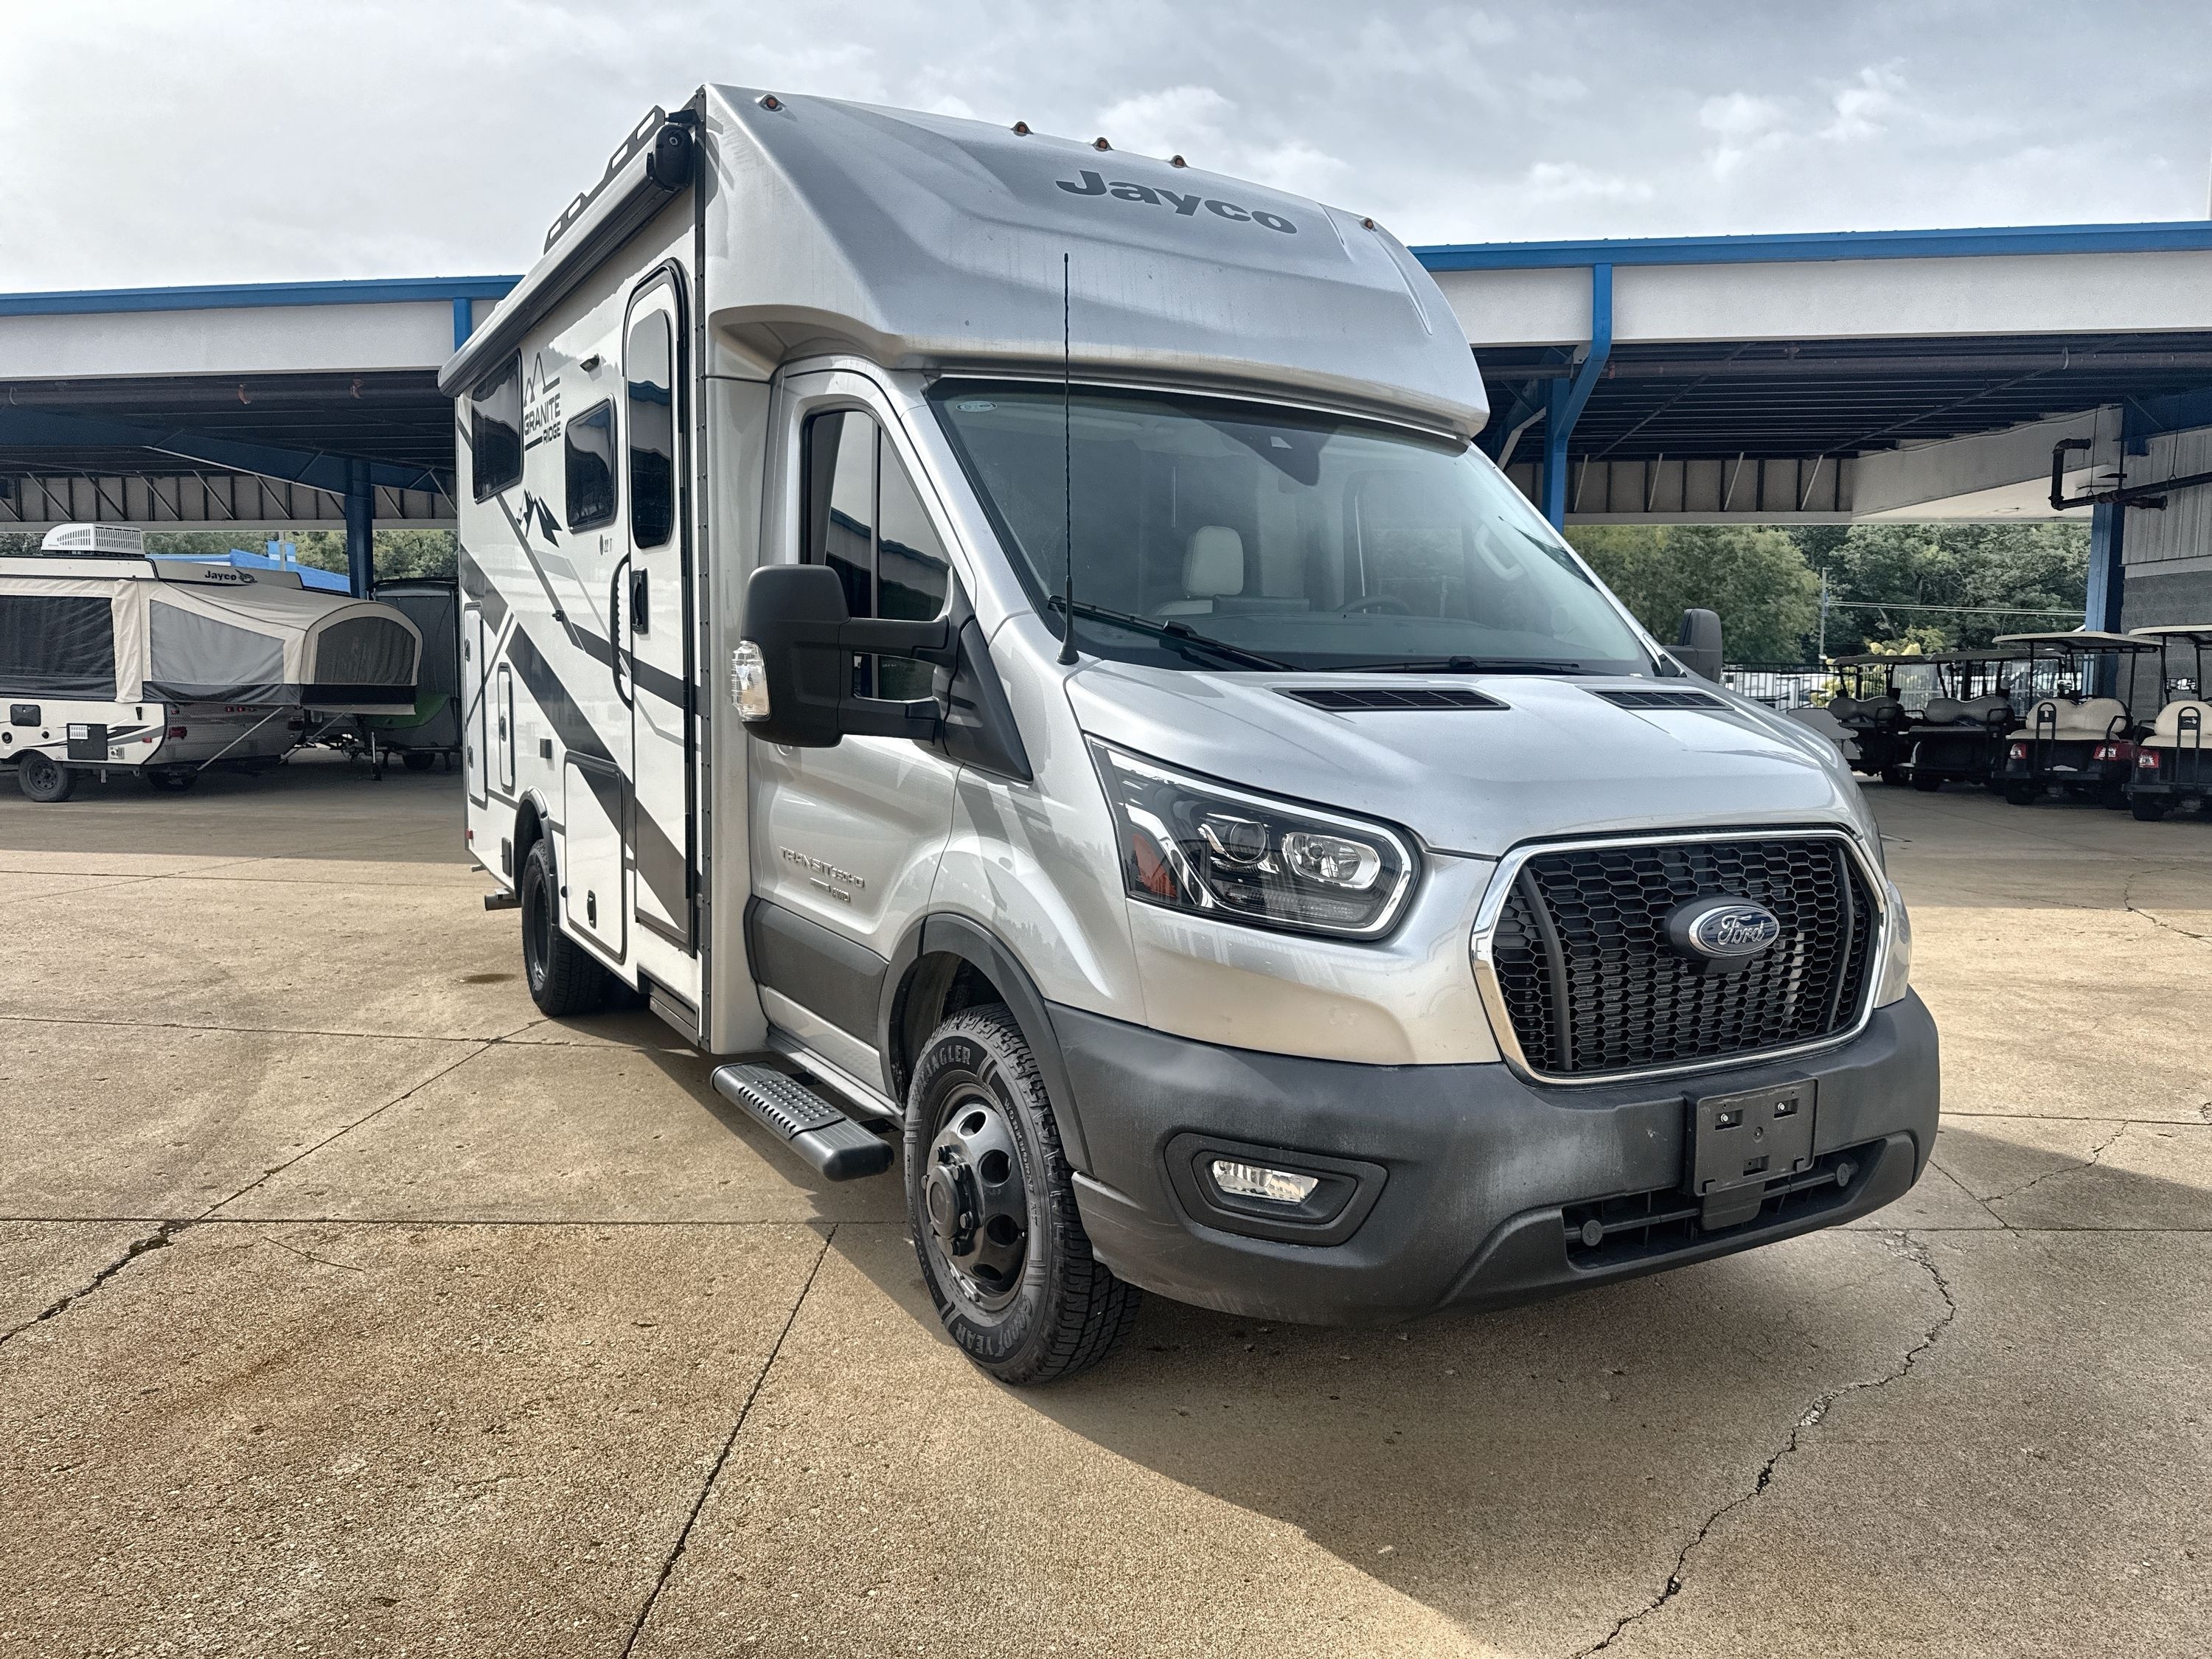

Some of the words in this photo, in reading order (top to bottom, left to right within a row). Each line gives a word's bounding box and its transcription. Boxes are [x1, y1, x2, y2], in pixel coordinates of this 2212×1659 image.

[1056, 170, 1298, 234] Jayco
[524, 392, 561, 437] GRANITE
[543, 420, 561, 445] RIDGE
[204, 571, 237, 581] Jayco
[1717, 914, 1765, 946] Ford
[912, 1044, 971, 1107] WRANGLER
[956, 1293, 1032, 1357] GOODYEAR
